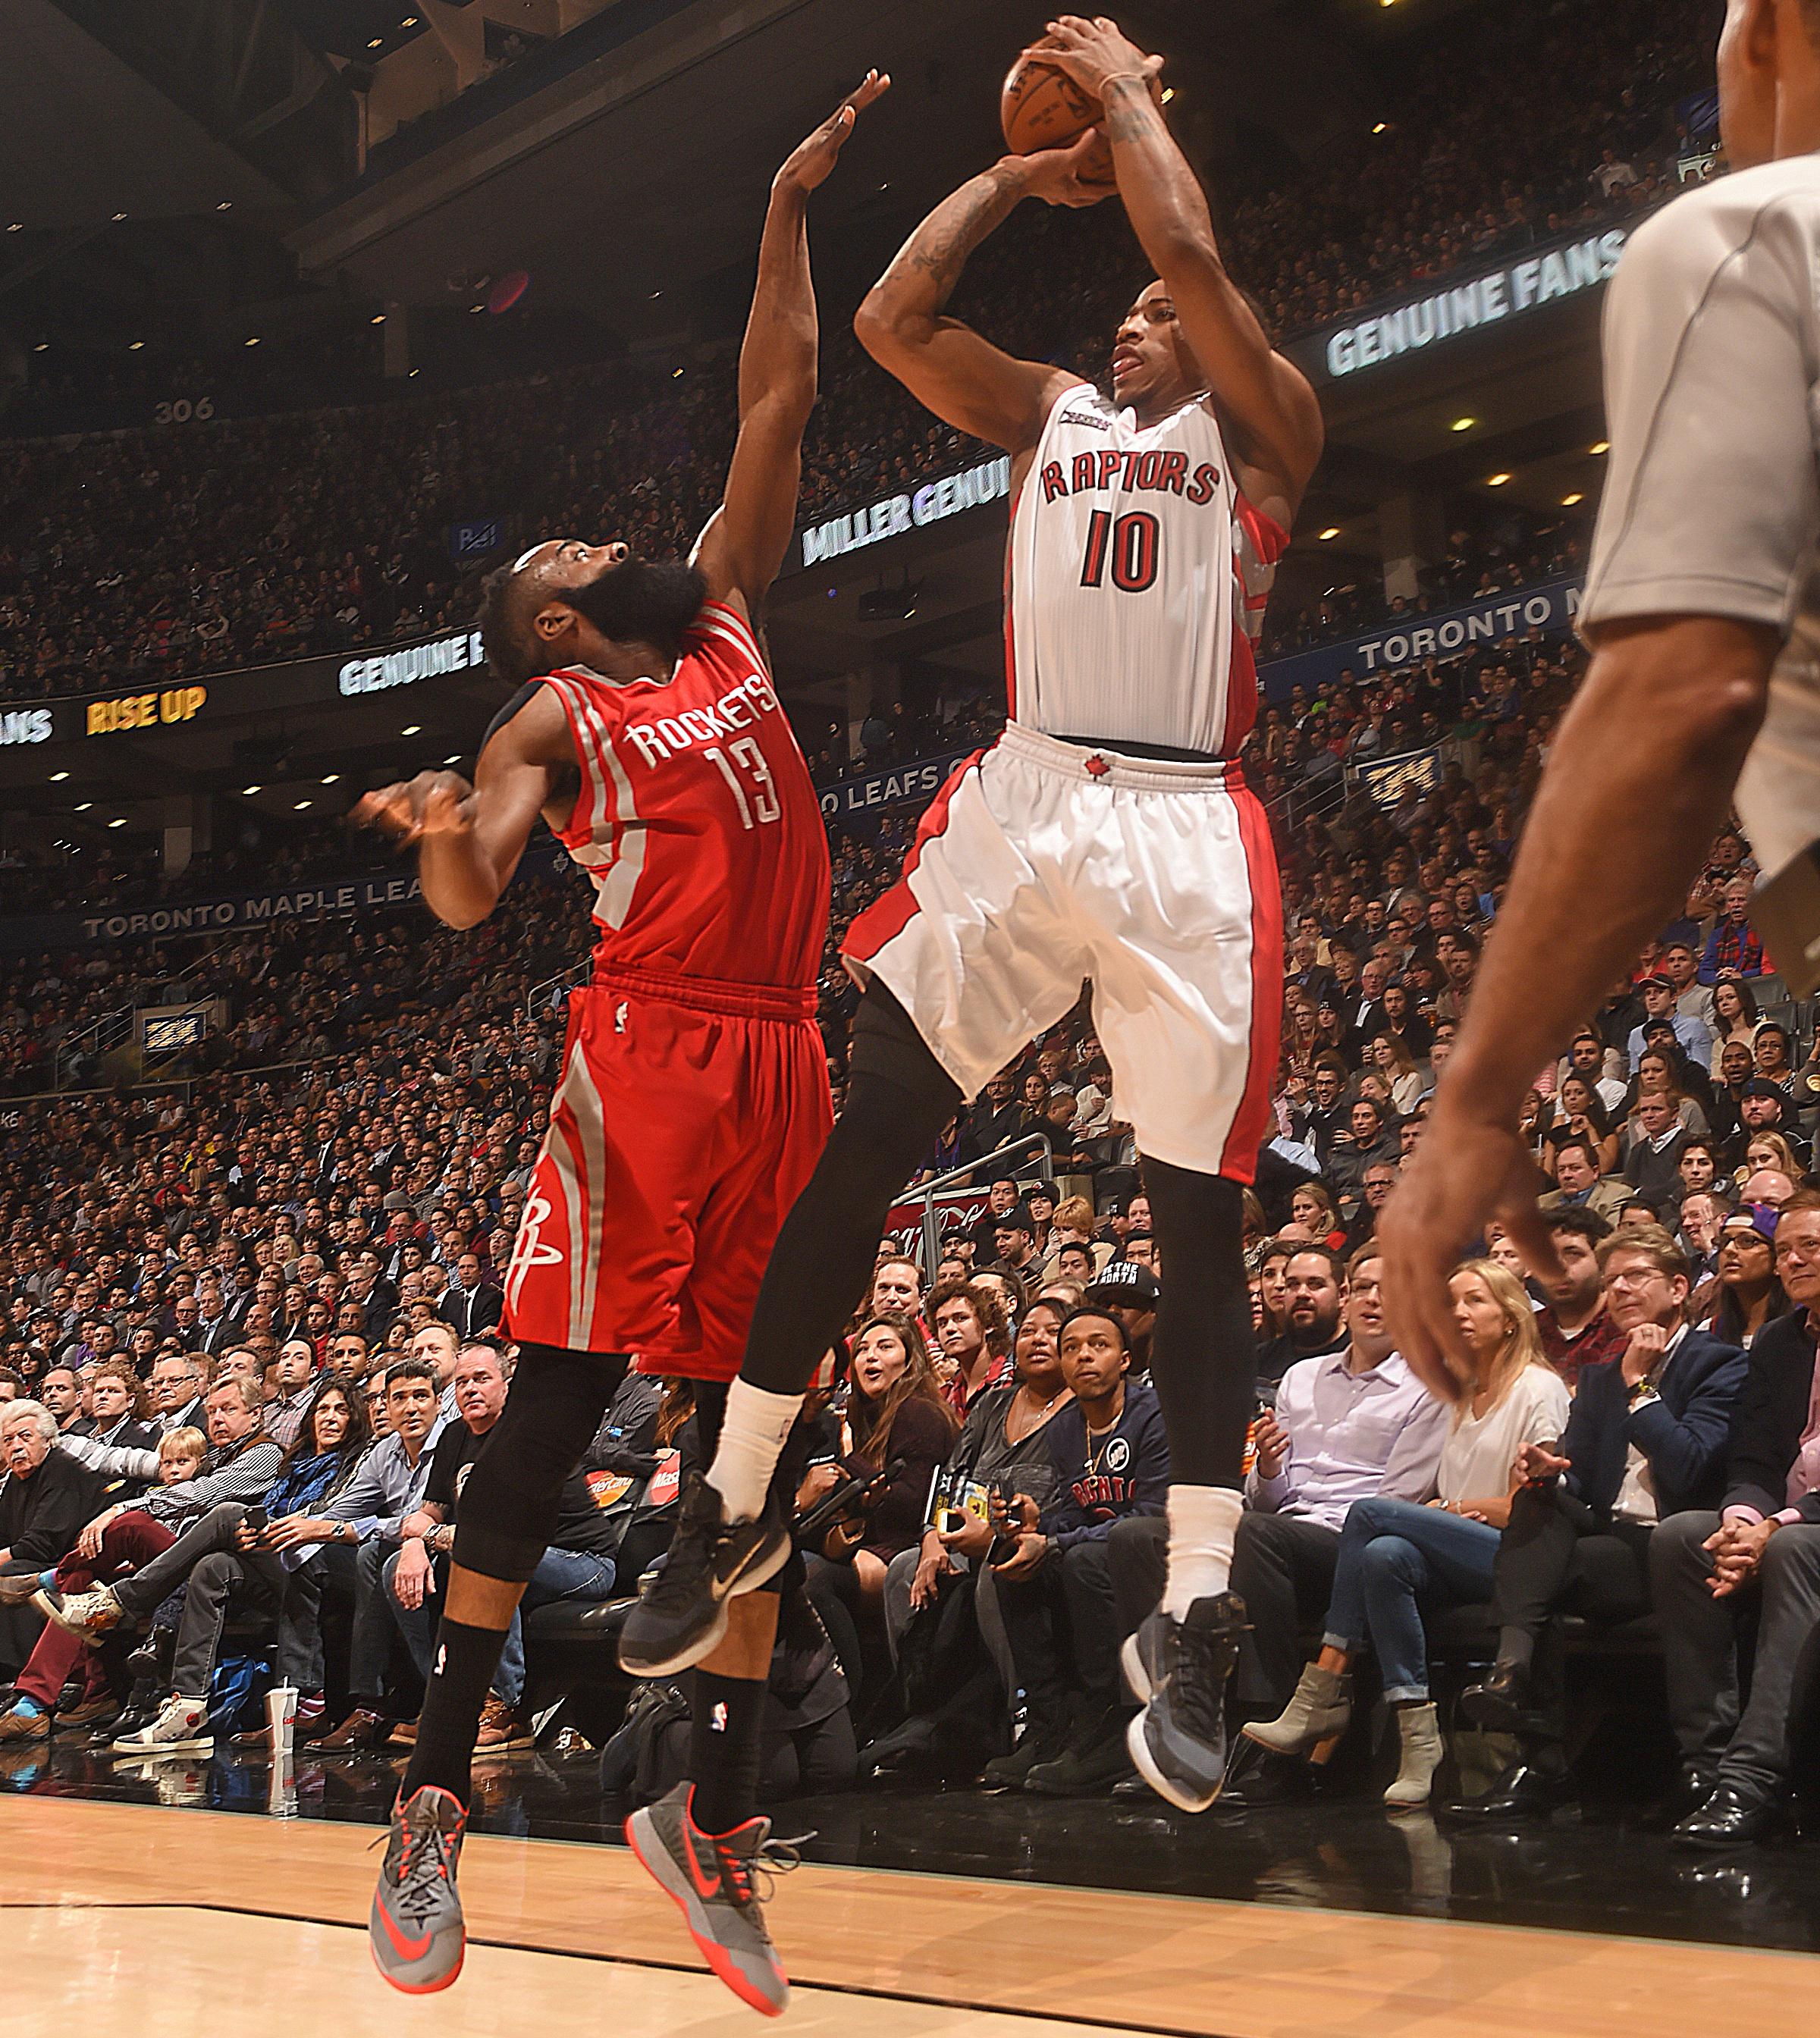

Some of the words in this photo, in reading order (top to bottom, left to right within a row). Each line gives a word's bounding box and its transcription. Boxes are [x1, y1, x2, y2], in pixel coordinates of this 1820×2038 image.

[1327, 271, 1509, 378] GENUINE
[1511, 228, 1627, 312] FANS
[155, 397, 215, 425] 306
[1042, 450, 1221, 504] RAPTORS
[802, 494, 912, 567] MILLER
[1080, 509, 1160, 593] 10
[1358, 596, 1552, 669] TORONTO
[339, 634, 469, 696] GENUINE
[87, 692, 158, 735] RISE
[160, 685, 207, 724] UP
[623, 674, 777, 770] ROCKETS
[703, 736, 781, 829] 13
[848, 766, 939, 810] LEAFS
[84, 902, 236, 938] TORONTO
[246, 887, 356, 920] MAPLE
[1115, 1262, 1138, 1274] THE
